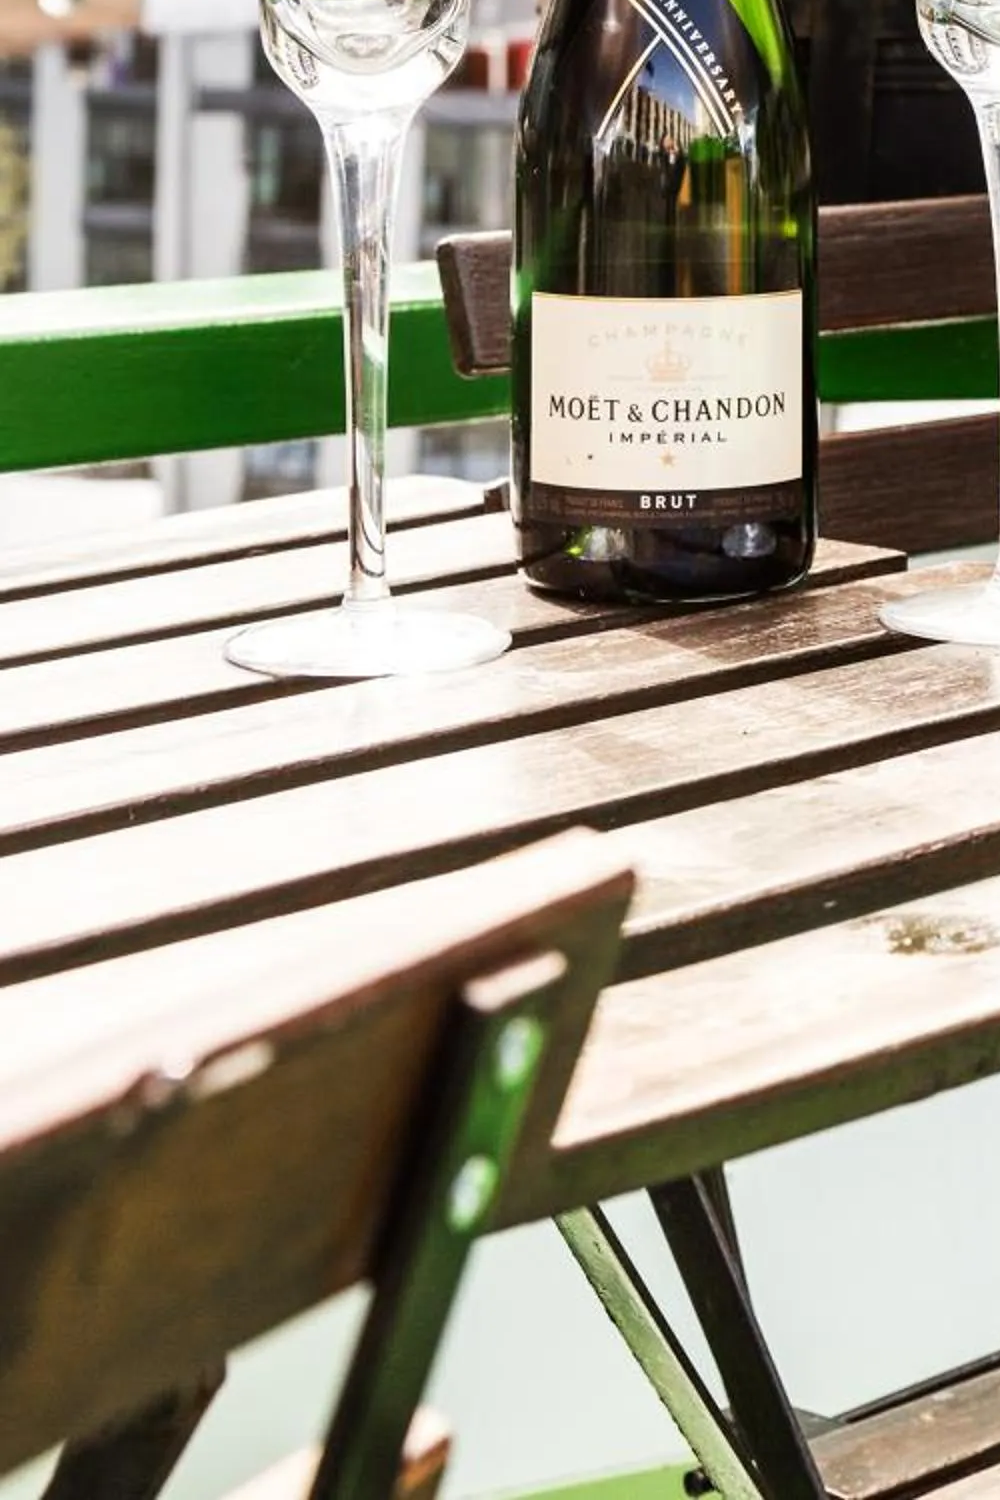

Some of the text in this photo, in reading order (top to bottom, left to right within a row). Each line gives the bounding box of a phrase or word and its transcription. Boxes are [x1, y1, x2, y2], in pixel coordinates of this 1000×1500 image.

[588, 322, 749, 348] CHAMPAGNE
[549, 391, 786, 423] MOËT & CHANDON
[609, 430, 728, 445] IMPÉRIAL
[640, 495, 697, 509] BRUT
